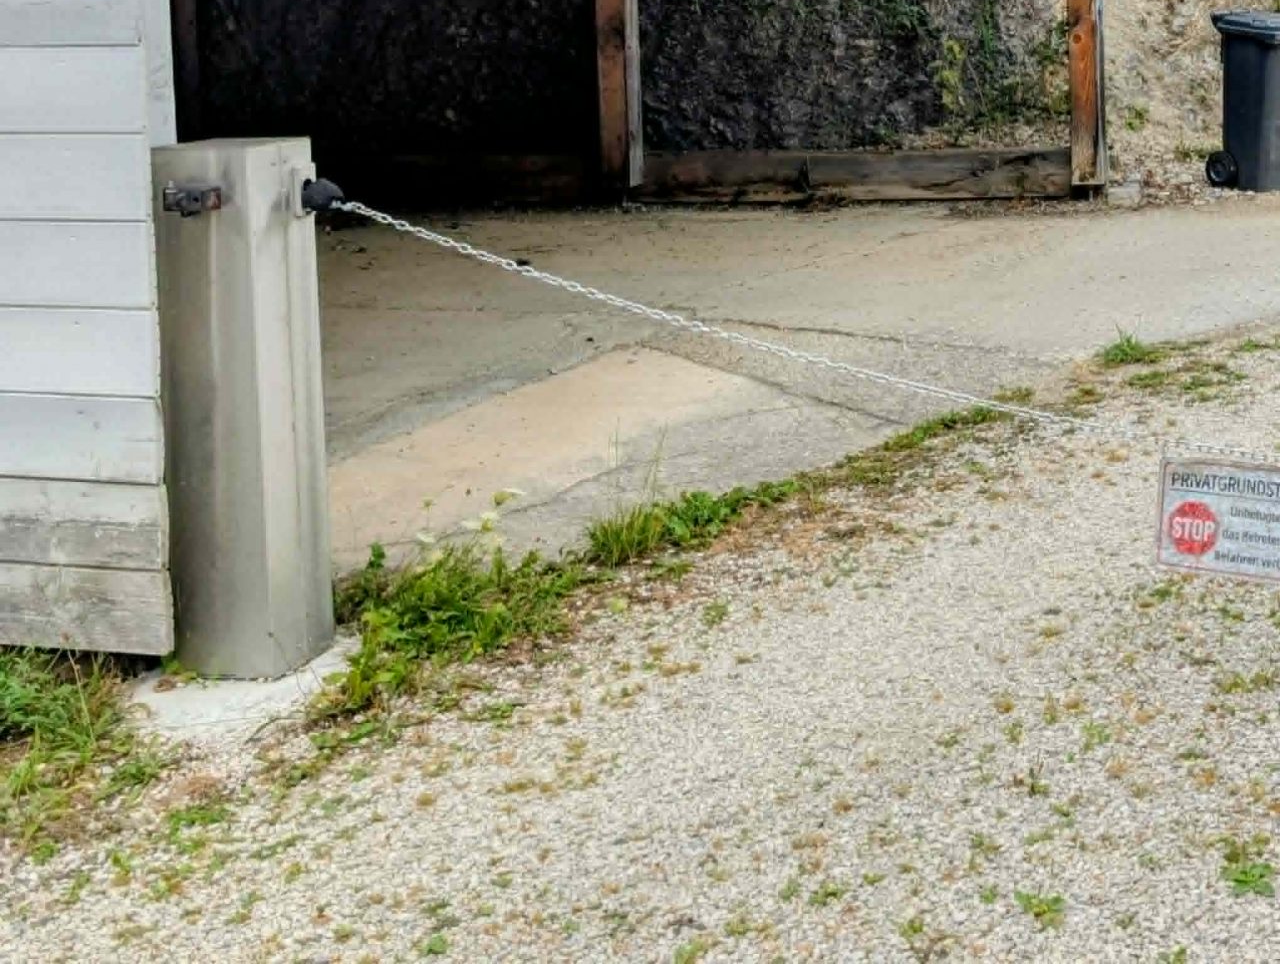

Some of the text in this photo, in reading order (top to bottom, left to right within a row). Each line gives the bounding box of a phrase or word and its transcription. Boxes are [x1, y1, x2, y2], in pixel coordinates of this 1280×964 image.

[1172, 516, 1216, 542] STOP
[1222, 529, 1239, 540] das
[1214, 550, 1258, 565] Befahren
